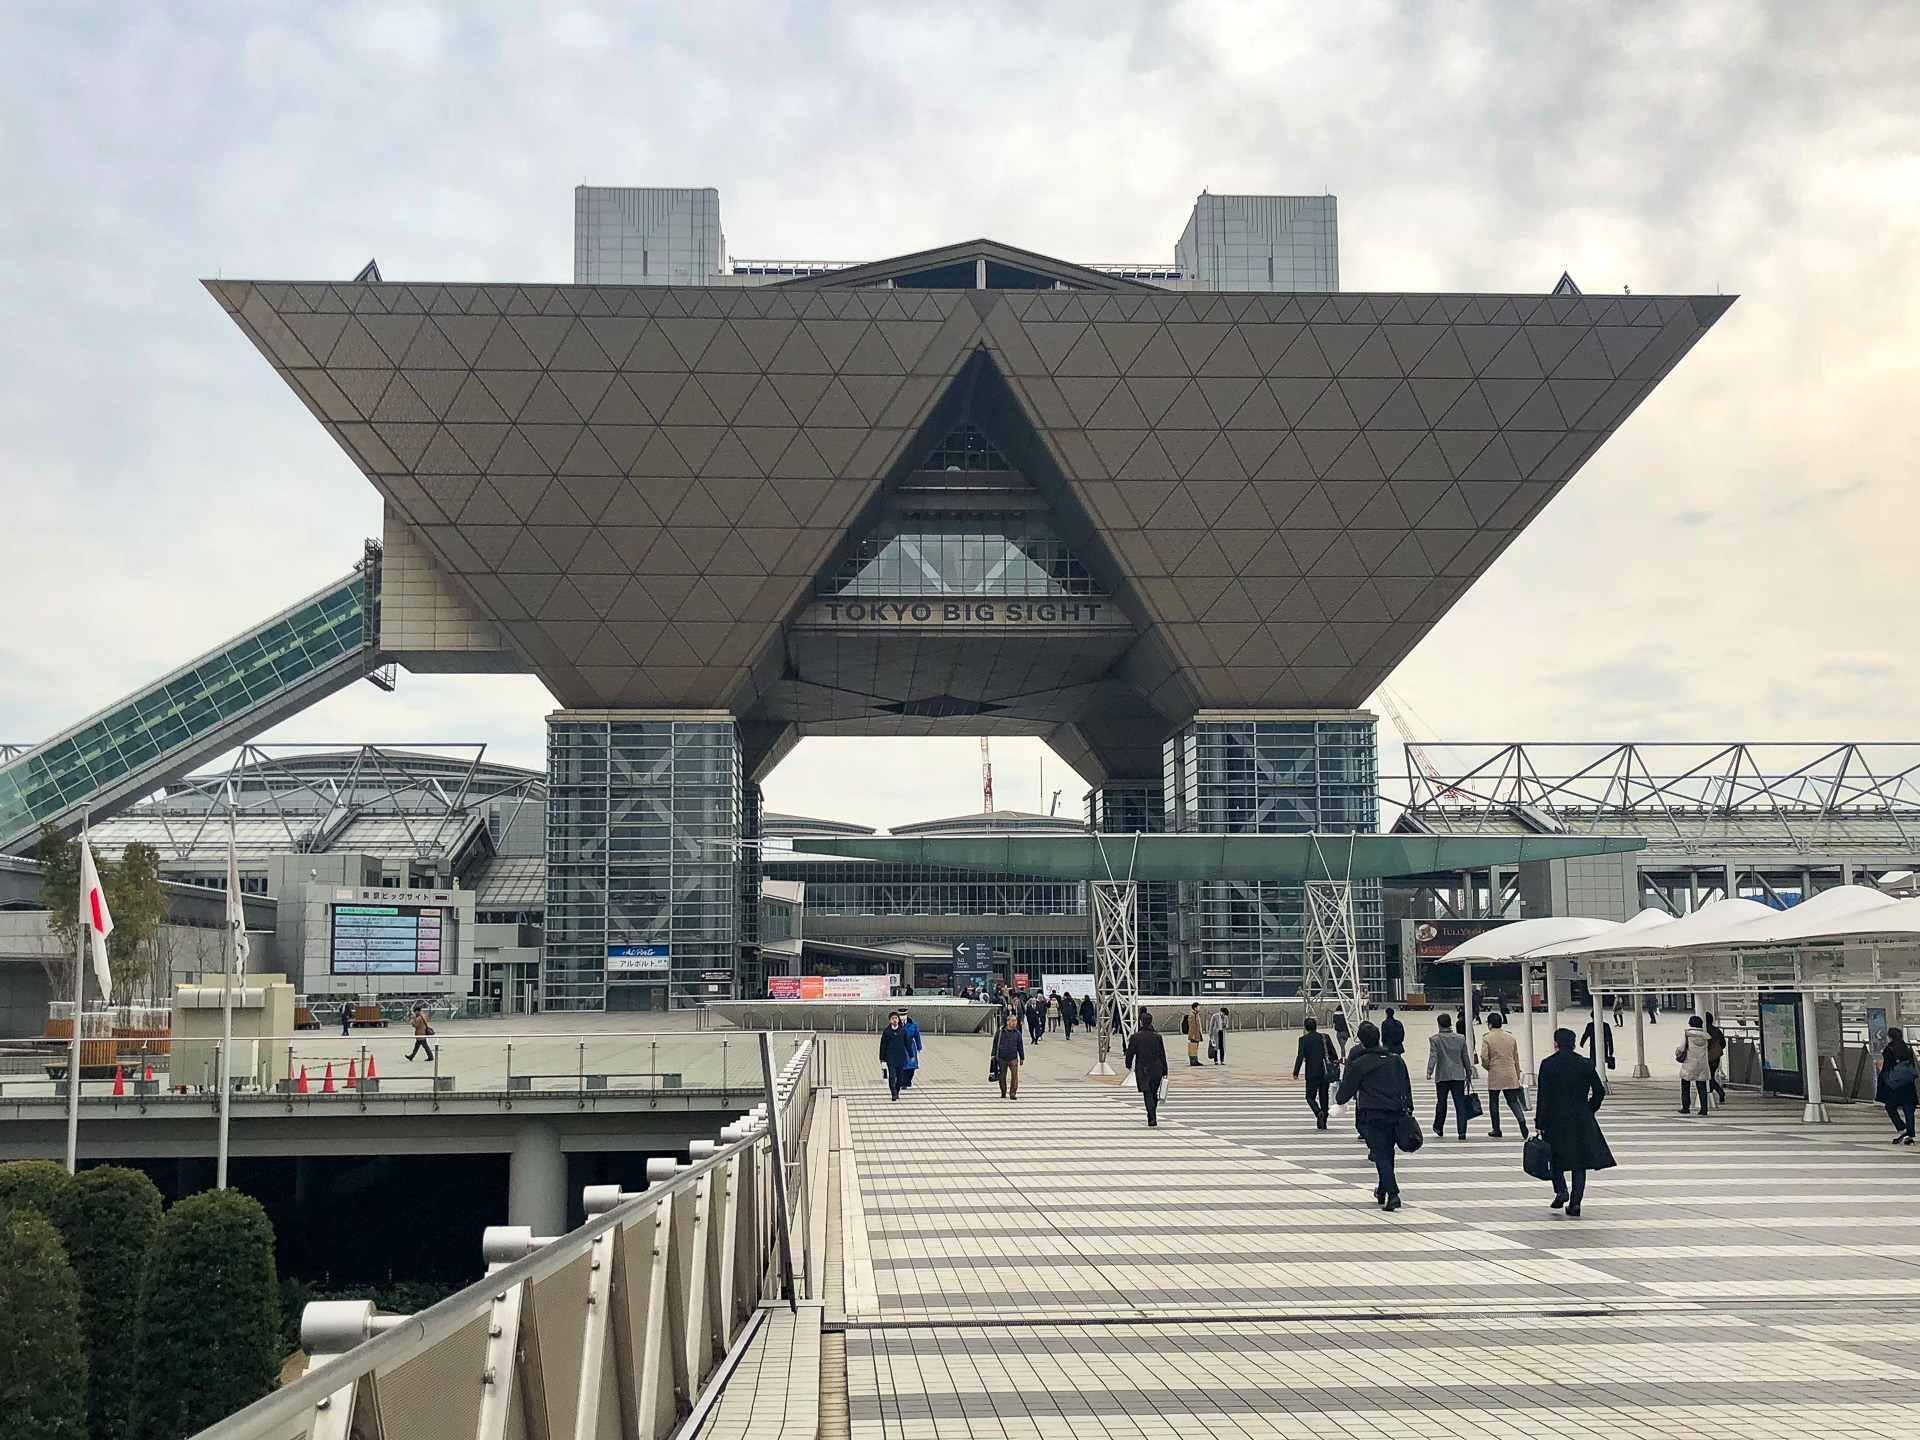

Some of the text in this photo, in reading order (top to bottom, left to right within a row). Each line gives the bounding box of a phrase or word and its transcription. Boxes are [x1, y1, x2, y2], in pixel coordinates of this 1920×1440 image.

[825, 603, 1102, 622] TOKYO BIG SIGHT
[362, 891, 429, 901] 東京ビッグサイト
